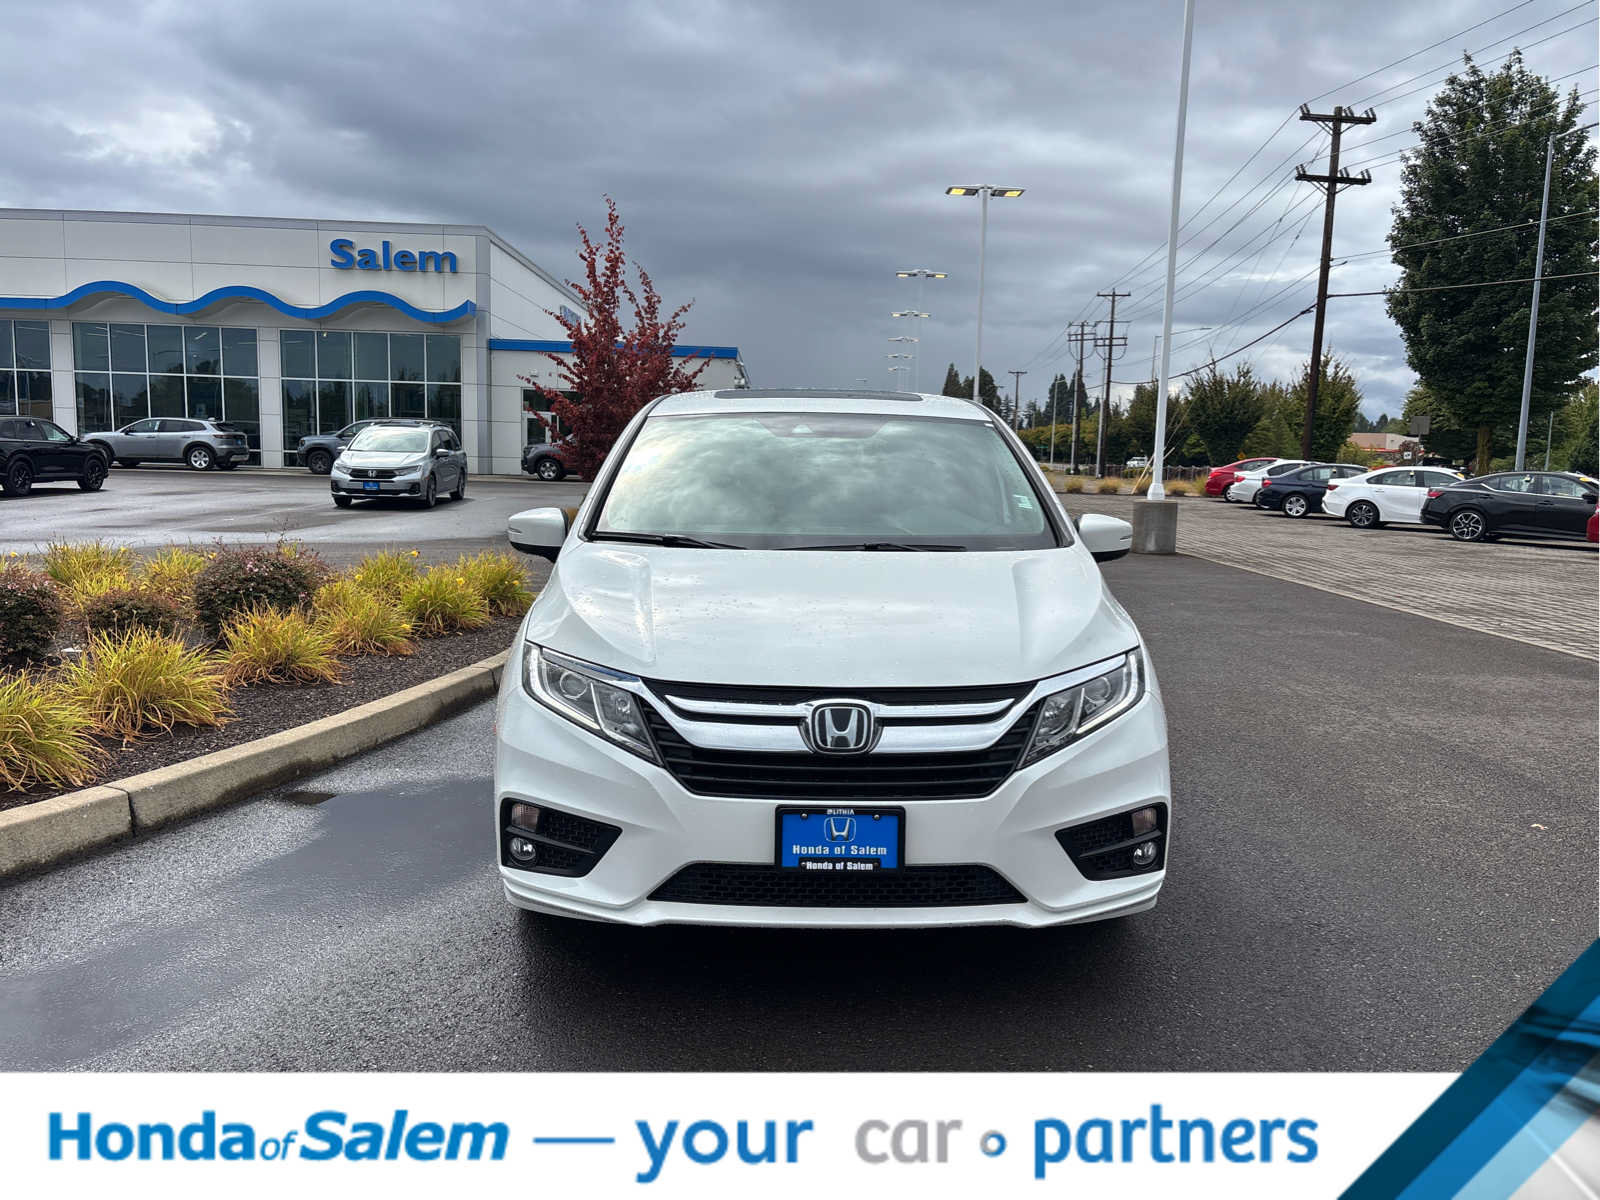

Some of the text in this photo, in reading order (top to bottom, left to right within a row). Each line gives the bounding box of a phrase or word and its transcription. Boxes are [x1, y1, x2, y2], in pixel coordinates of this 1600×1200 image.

[329, 238, 457, 272] Salem
[792, 845, 887, 855] Honda of Salem
[806, 861, 873, 870] Honda of Salem
